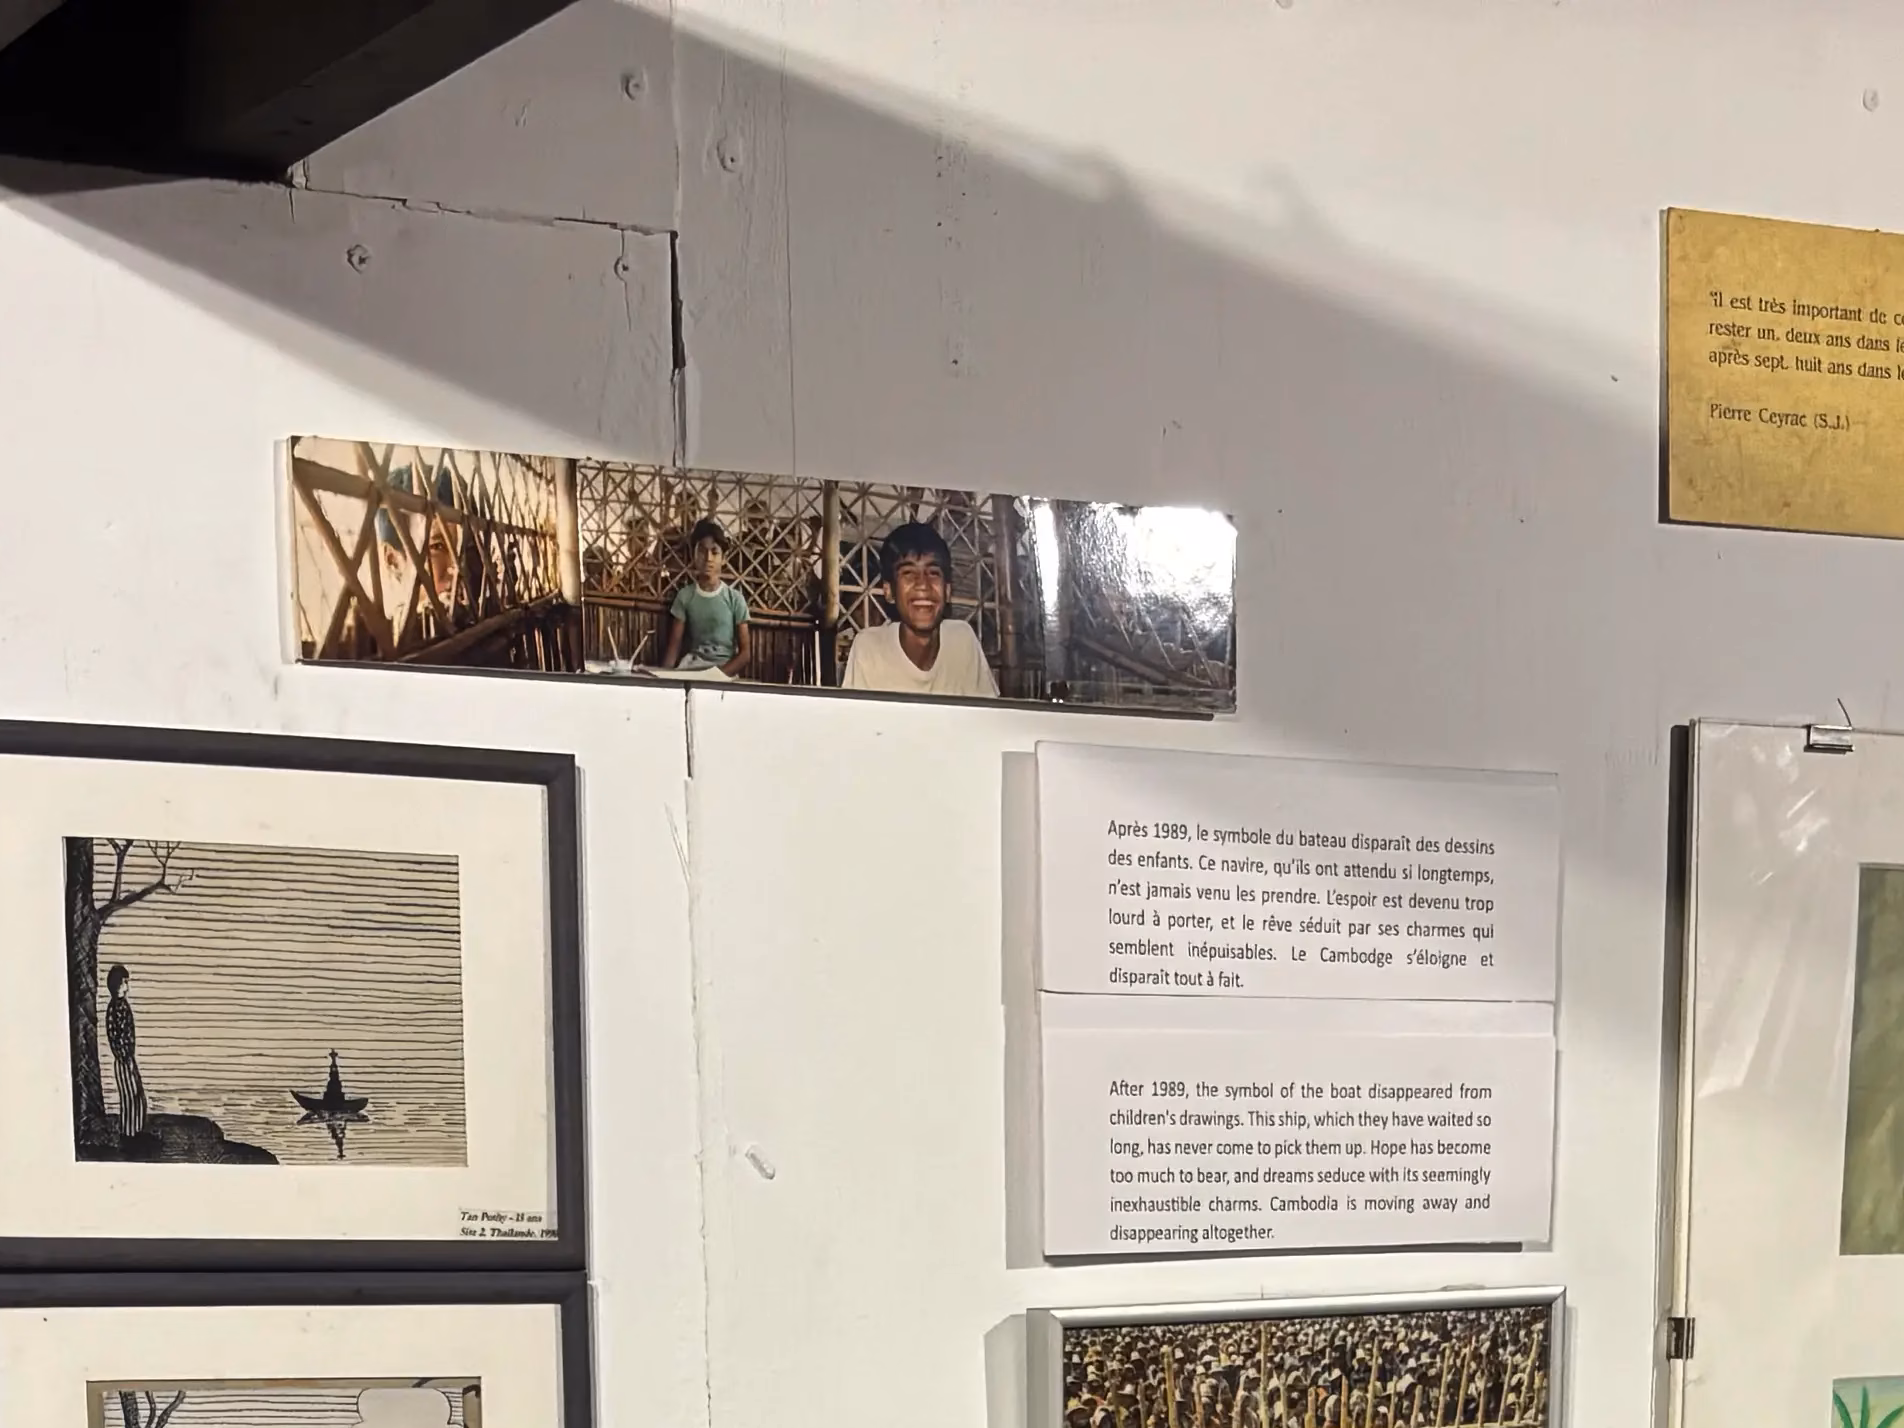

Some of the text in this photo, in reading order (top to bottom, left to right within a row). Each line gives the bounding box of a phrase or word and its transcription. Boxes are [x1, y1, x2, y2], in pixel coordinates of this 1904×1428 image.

[1107, 819, 1149, 840] Après
[1152, 821, 1192, 843] 1989,
[1196, 823, 1209, 842] le
[1212, 826, 1272, 847] symbole
[1275, 828, 1294, 846] du
[1298, 829, 1347, 849] bateau
[1415, 835, 1441, 853] des
[1444, 835, 1496, 856] dessins
[1107, 847, 1133, 867] des
[1137, 850, 1194, 871] enfants.
[1198, 853, 1217, 871] Ce
[1220, 855, 1269, 877] navire,
[1315, 861, 1339, 877] ont
[1343, 861, 1397, 880] attendu
[1401, 863, 1413, 881] si
[1417, 863, 1495, 887] longtemps,
[1145, 880, 1192, 901] jamais
[1195, 886, 1231, 901] venu
[1236, 883, 1256, 903] les
[1261, 887, 1321, 907] prendre.
[1382, 893, 1403, 909] est
[1407, 891, 1461, 911] devenu
[1464, 895, 1495, 915] trop
[1108, 907, 1495, 943] lourd à porter, et le rêve séduit par ses charmes qui
[1108, 937, 1175, 957] semblent
[1187, 939, 1277, 963] inépuisables.
[1291, 945, 1307, 962] Le
[1319, 946, 1393, 969] Cambodge
[1479, 951, 1495, 967] et
[1173, 971, 1204, 987] tout
[1206, 969, 1215, 987] à
[1218, 970, 1245, 989] fait.
[1109, 1079, 1493, 1103] After 1989, the symbol of the boat disappeared from
[1109, 1108, 1492, 1131] children's drawings. This ship, which they have waited so
[1109, 1137, 1492, 1159] long, has never come to pick them up. Hope has become
[1109, 1165, 1492, 1186] too much to bear, and dreams seduce with its seemingly
[1110, 1193, 1491, 1215] inexhaustible charms. Cambodia is moving away and
[1109, 1223, 1275, 1245] disappearing altogether.
